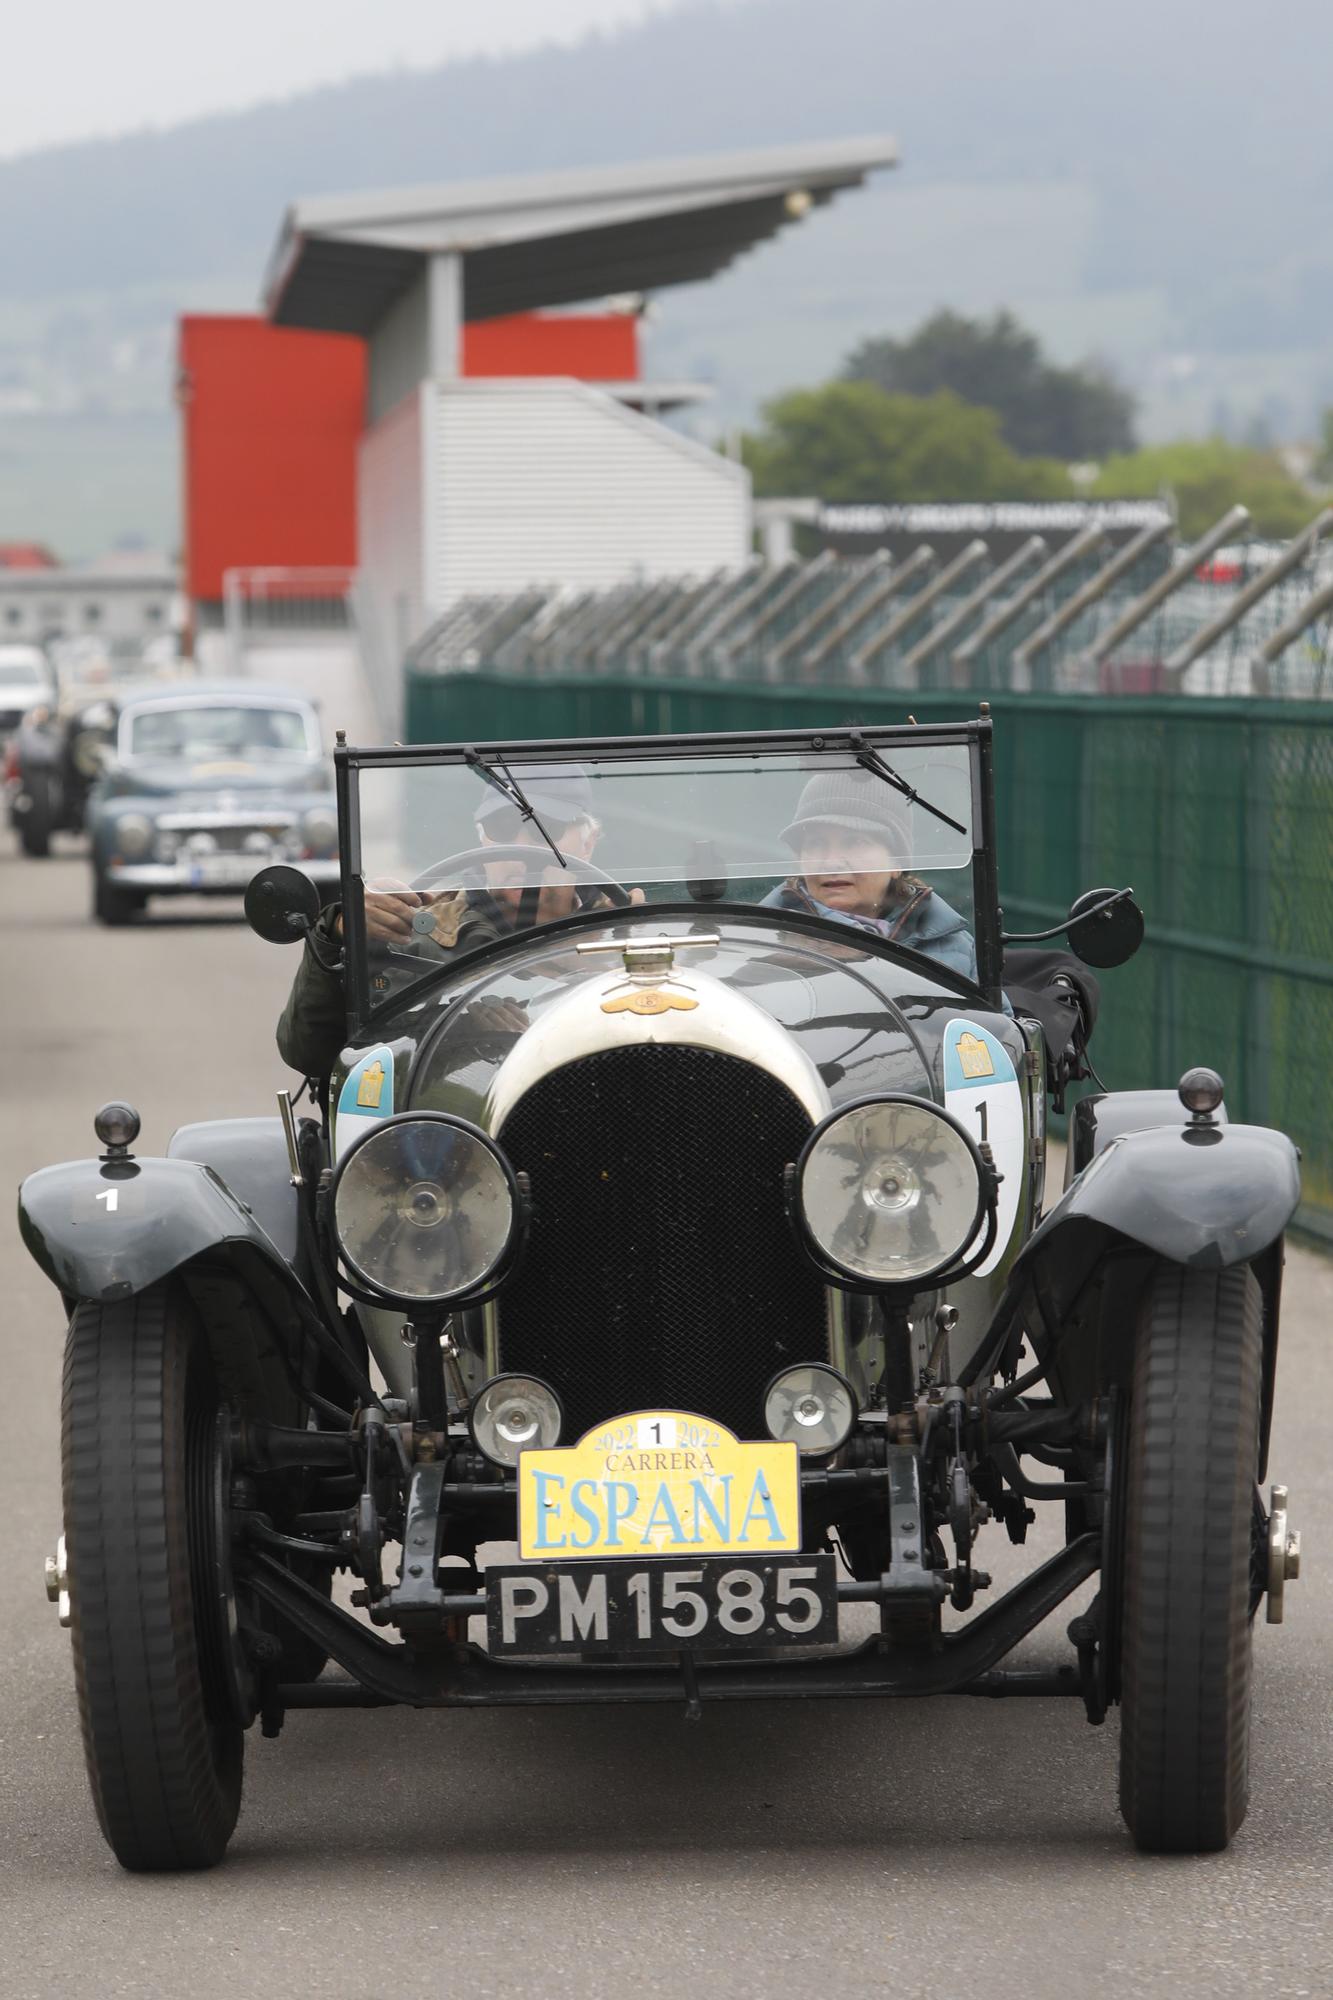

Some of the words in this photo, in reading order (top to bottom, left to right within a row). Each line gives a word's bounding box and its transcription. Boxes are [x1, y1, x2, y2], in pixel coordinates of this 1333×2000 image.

[975, 1101, 988, 1141] 1
[96, 1188, 118, 1211] 1
[594, 1425, 634, 1450] 2022
[650, 1423, 661, 1444] 1
[678, 1422, 721, 1447] 2022
[606, 1453, 714, 1472] CARRERA
[531, 1469, 786, 1549] ESPAÑA
